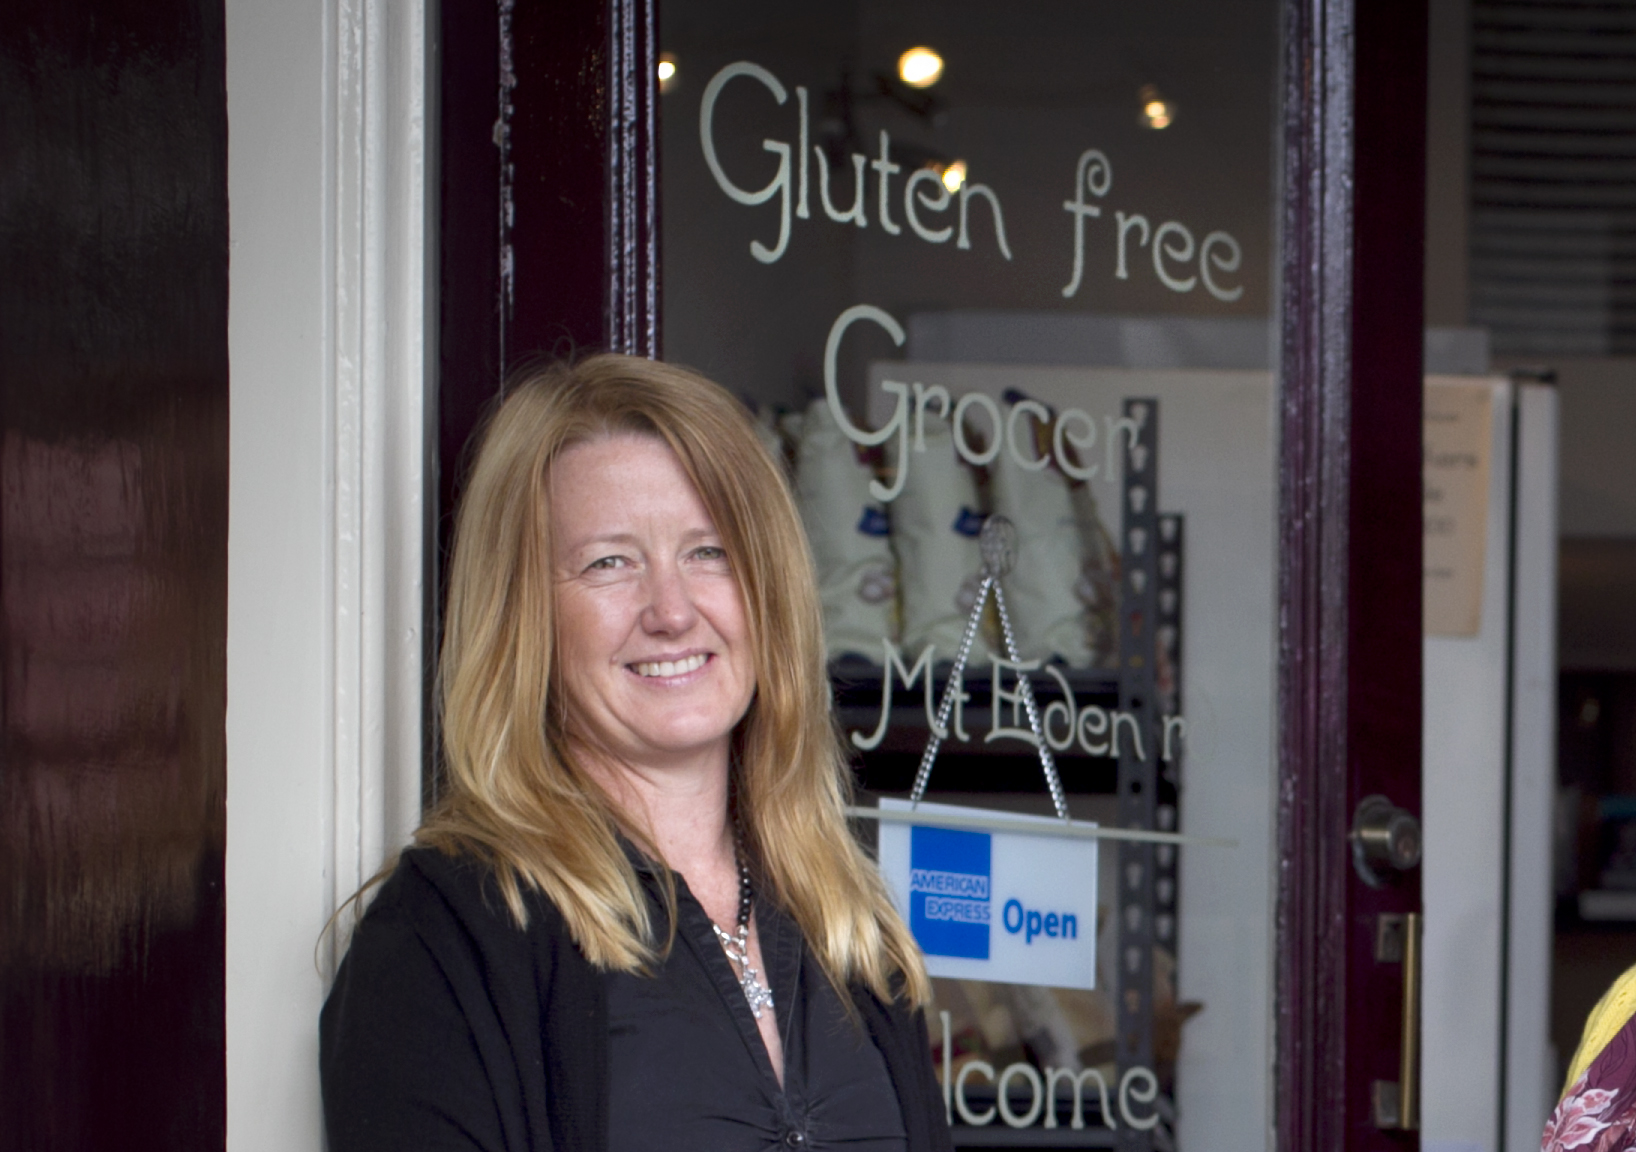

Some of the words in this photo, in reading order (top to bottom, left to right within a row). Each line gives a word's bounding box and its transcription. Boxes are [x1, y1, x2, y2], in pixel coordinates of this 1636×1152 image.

[701, 61, 1012, 264] Gluten
[1062, 148, 1244, 300] free
[823, 304, 1139, 502] Grocer
[985, 652, 1147, 760] Eden
[911, 871, 986, 896] AMERICAN
[926, 900, 991, 921] EXPRESS
[1003, 898, 1078, 945] Open
[939, 1011, 1160, 1131] lcome
